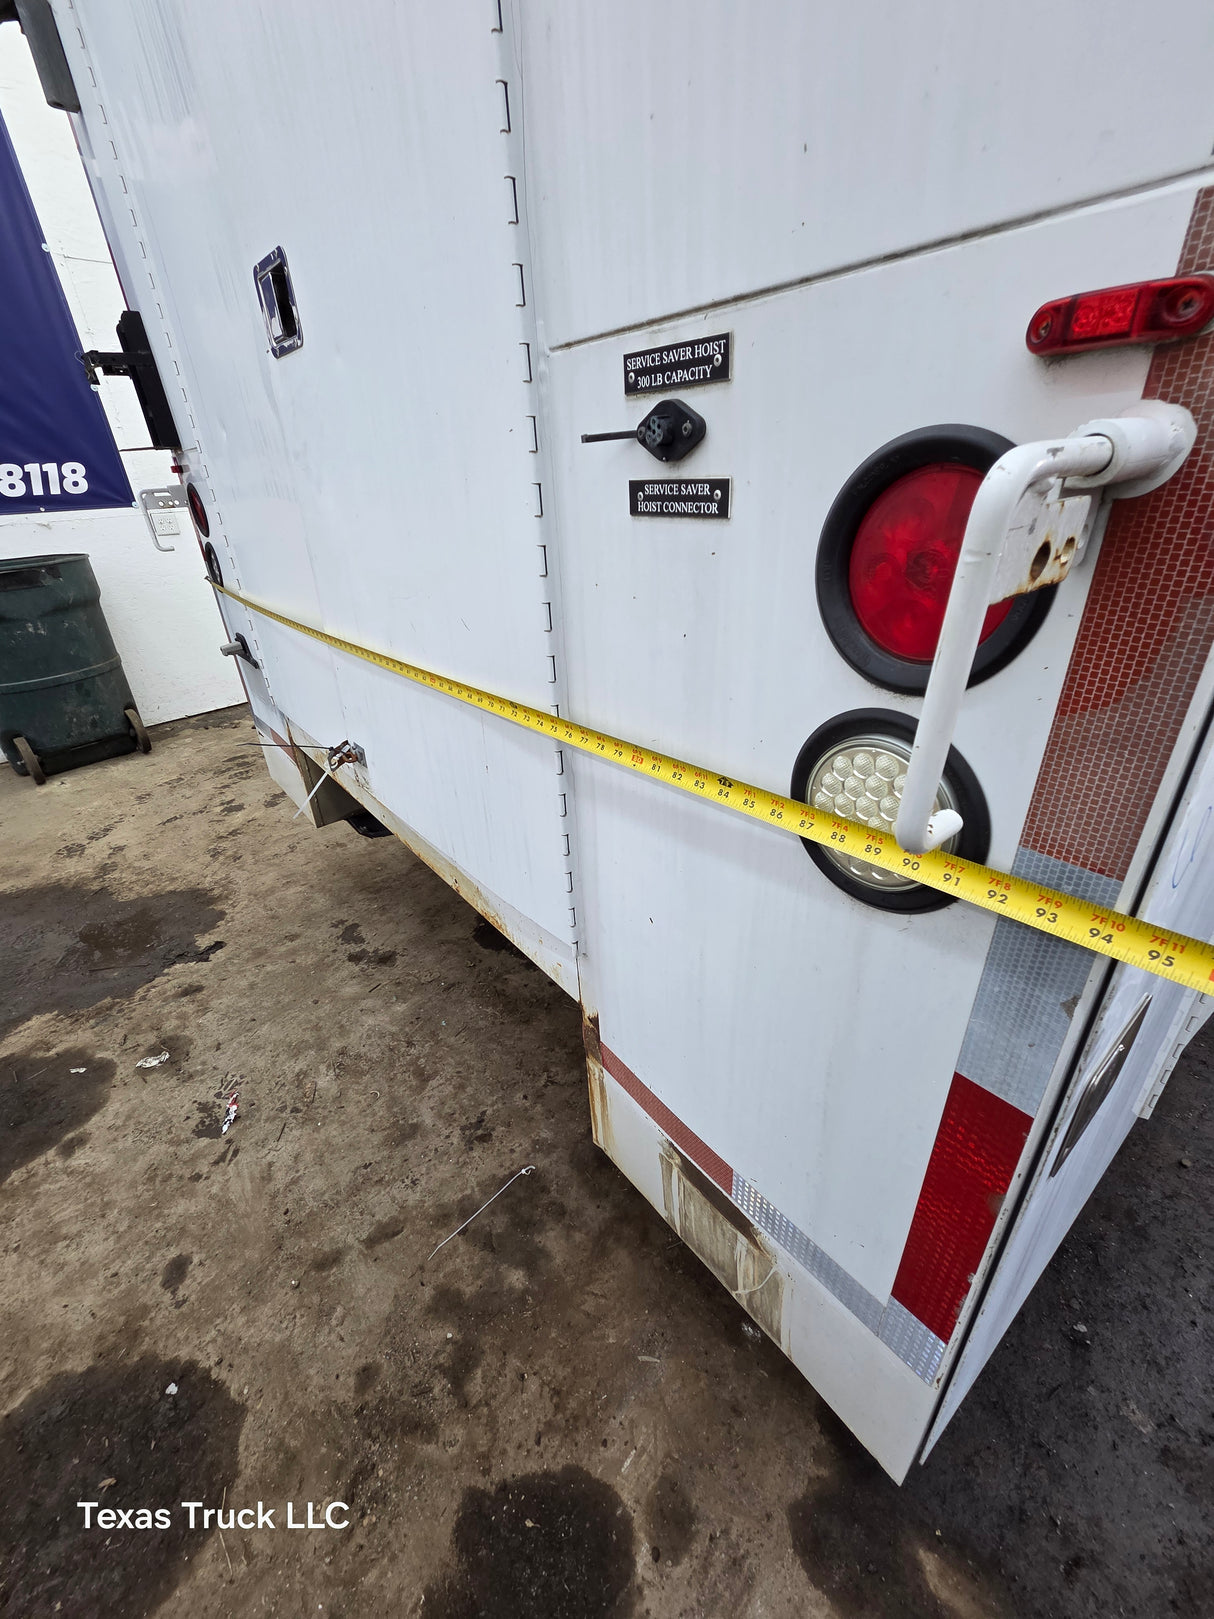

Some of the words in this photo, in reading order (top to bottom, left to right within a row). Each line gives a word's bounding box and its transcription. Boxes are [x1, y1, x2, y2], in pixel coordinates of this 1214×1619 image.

[627, 353, 661, 371] SERVICE
[663, 346, 692, 364] SAVER
[695, 340, 726, 358] HOIST
[637, 375, 650, 389] 300
[651, 373, 663, 386] LB
[664, 365, 713, 384] CAPACITY
[0, 461, 89, 498] 8118
[644, 483, 679, 496] SERVICE
[681, 483, 711, 496] SAVER
[637, 501, 662, 512] HOIST
[663, 501, 719, 514] CONNECTOR
[511, 709, 518, 717] 72
[523, 714, 530, 722] 73
[536, 719, 544, 727] 74
[550, 725, 558, 733] 75
[565, 730, 573, 738] 76
[580, 736, 588, 744] 77
[596, 742, 605, 751] 78
[614, 749, 623, 758] 79
[652, 763, 661, 772] 81
[672, 771, 682, 781] 82
[694, 780, 705, 789] 83
[717, 789, 730, 798] 84
[742, 798, 756, 808] 85
[770, 809, 783, 819] 86
[799, 820, 815, 830] 87
[830, 831, 846, 843] 88
[864, 844, 882, 855] 89
[902, 858, 920, 870] 90
[943, 873, 961, 886] 91
[987, 889, 1008, 904] 92
[1035, 907, 1058, 923] 93
[1088, 927, 1114, 944] 94
[1147, 949, 1175, 967] 95
[800, 809, 809, 817] 7F
[831, 821, 841, 829] 7F
[865, 833, 876, 841] 7F
[943, 861, 957, 871] 7F
[957, 865, 966, 874] 7
[988, 877, 1003, 887] 7F
[1003, 882, 1012, 891] 8
[1036, 894, 1052, 904] 7F
[1054, 900, 1063, 909] 9
[1090, 913, 1108, 925] 7F
[1110, 919, 1126, 933] 10
[1149, 934, 1169, 947] 7F
[1172, 942, 1186, 954] 11
